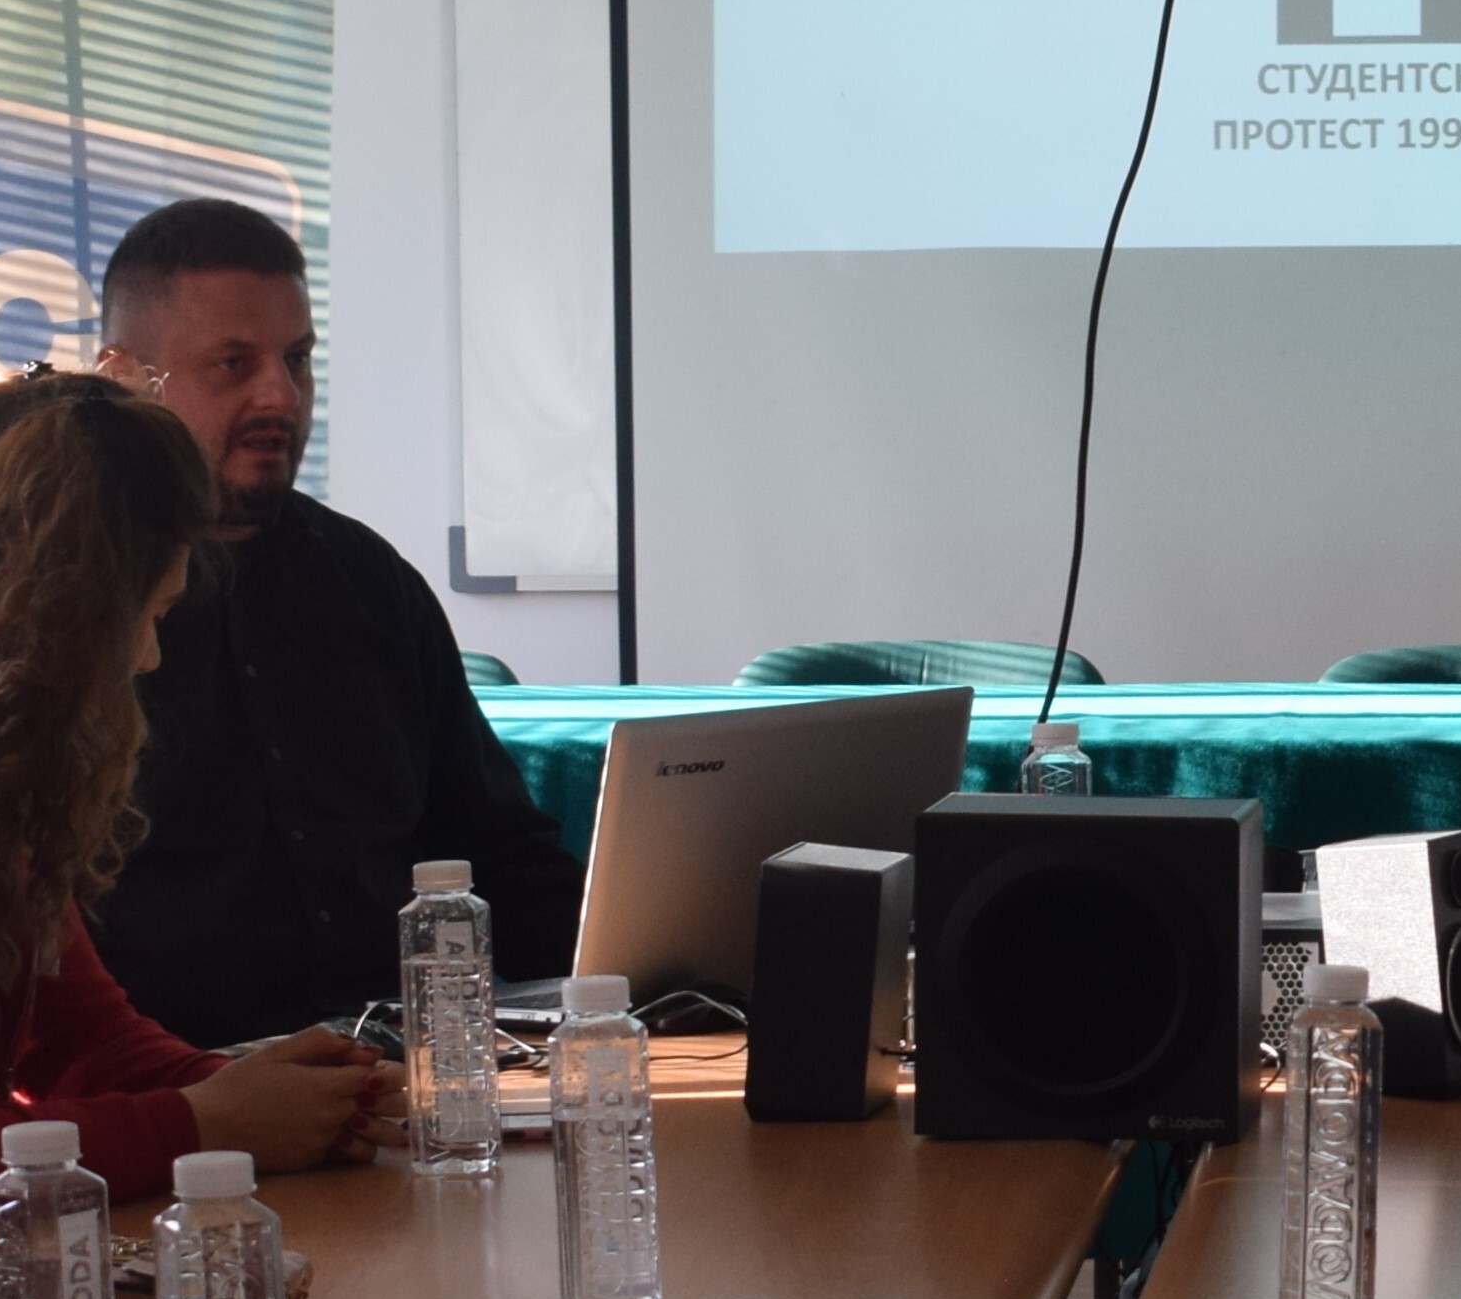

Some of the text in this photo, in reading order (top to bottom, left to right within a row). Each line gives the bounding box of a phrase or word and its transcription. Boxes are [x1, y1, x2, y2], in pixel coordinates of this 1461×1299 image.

[1213, 117, 1385, 152] ПРОТЕСТ
[655, 760, 726, 777] lenovo
[1169, 1116, 1225, 1131] Logitech
